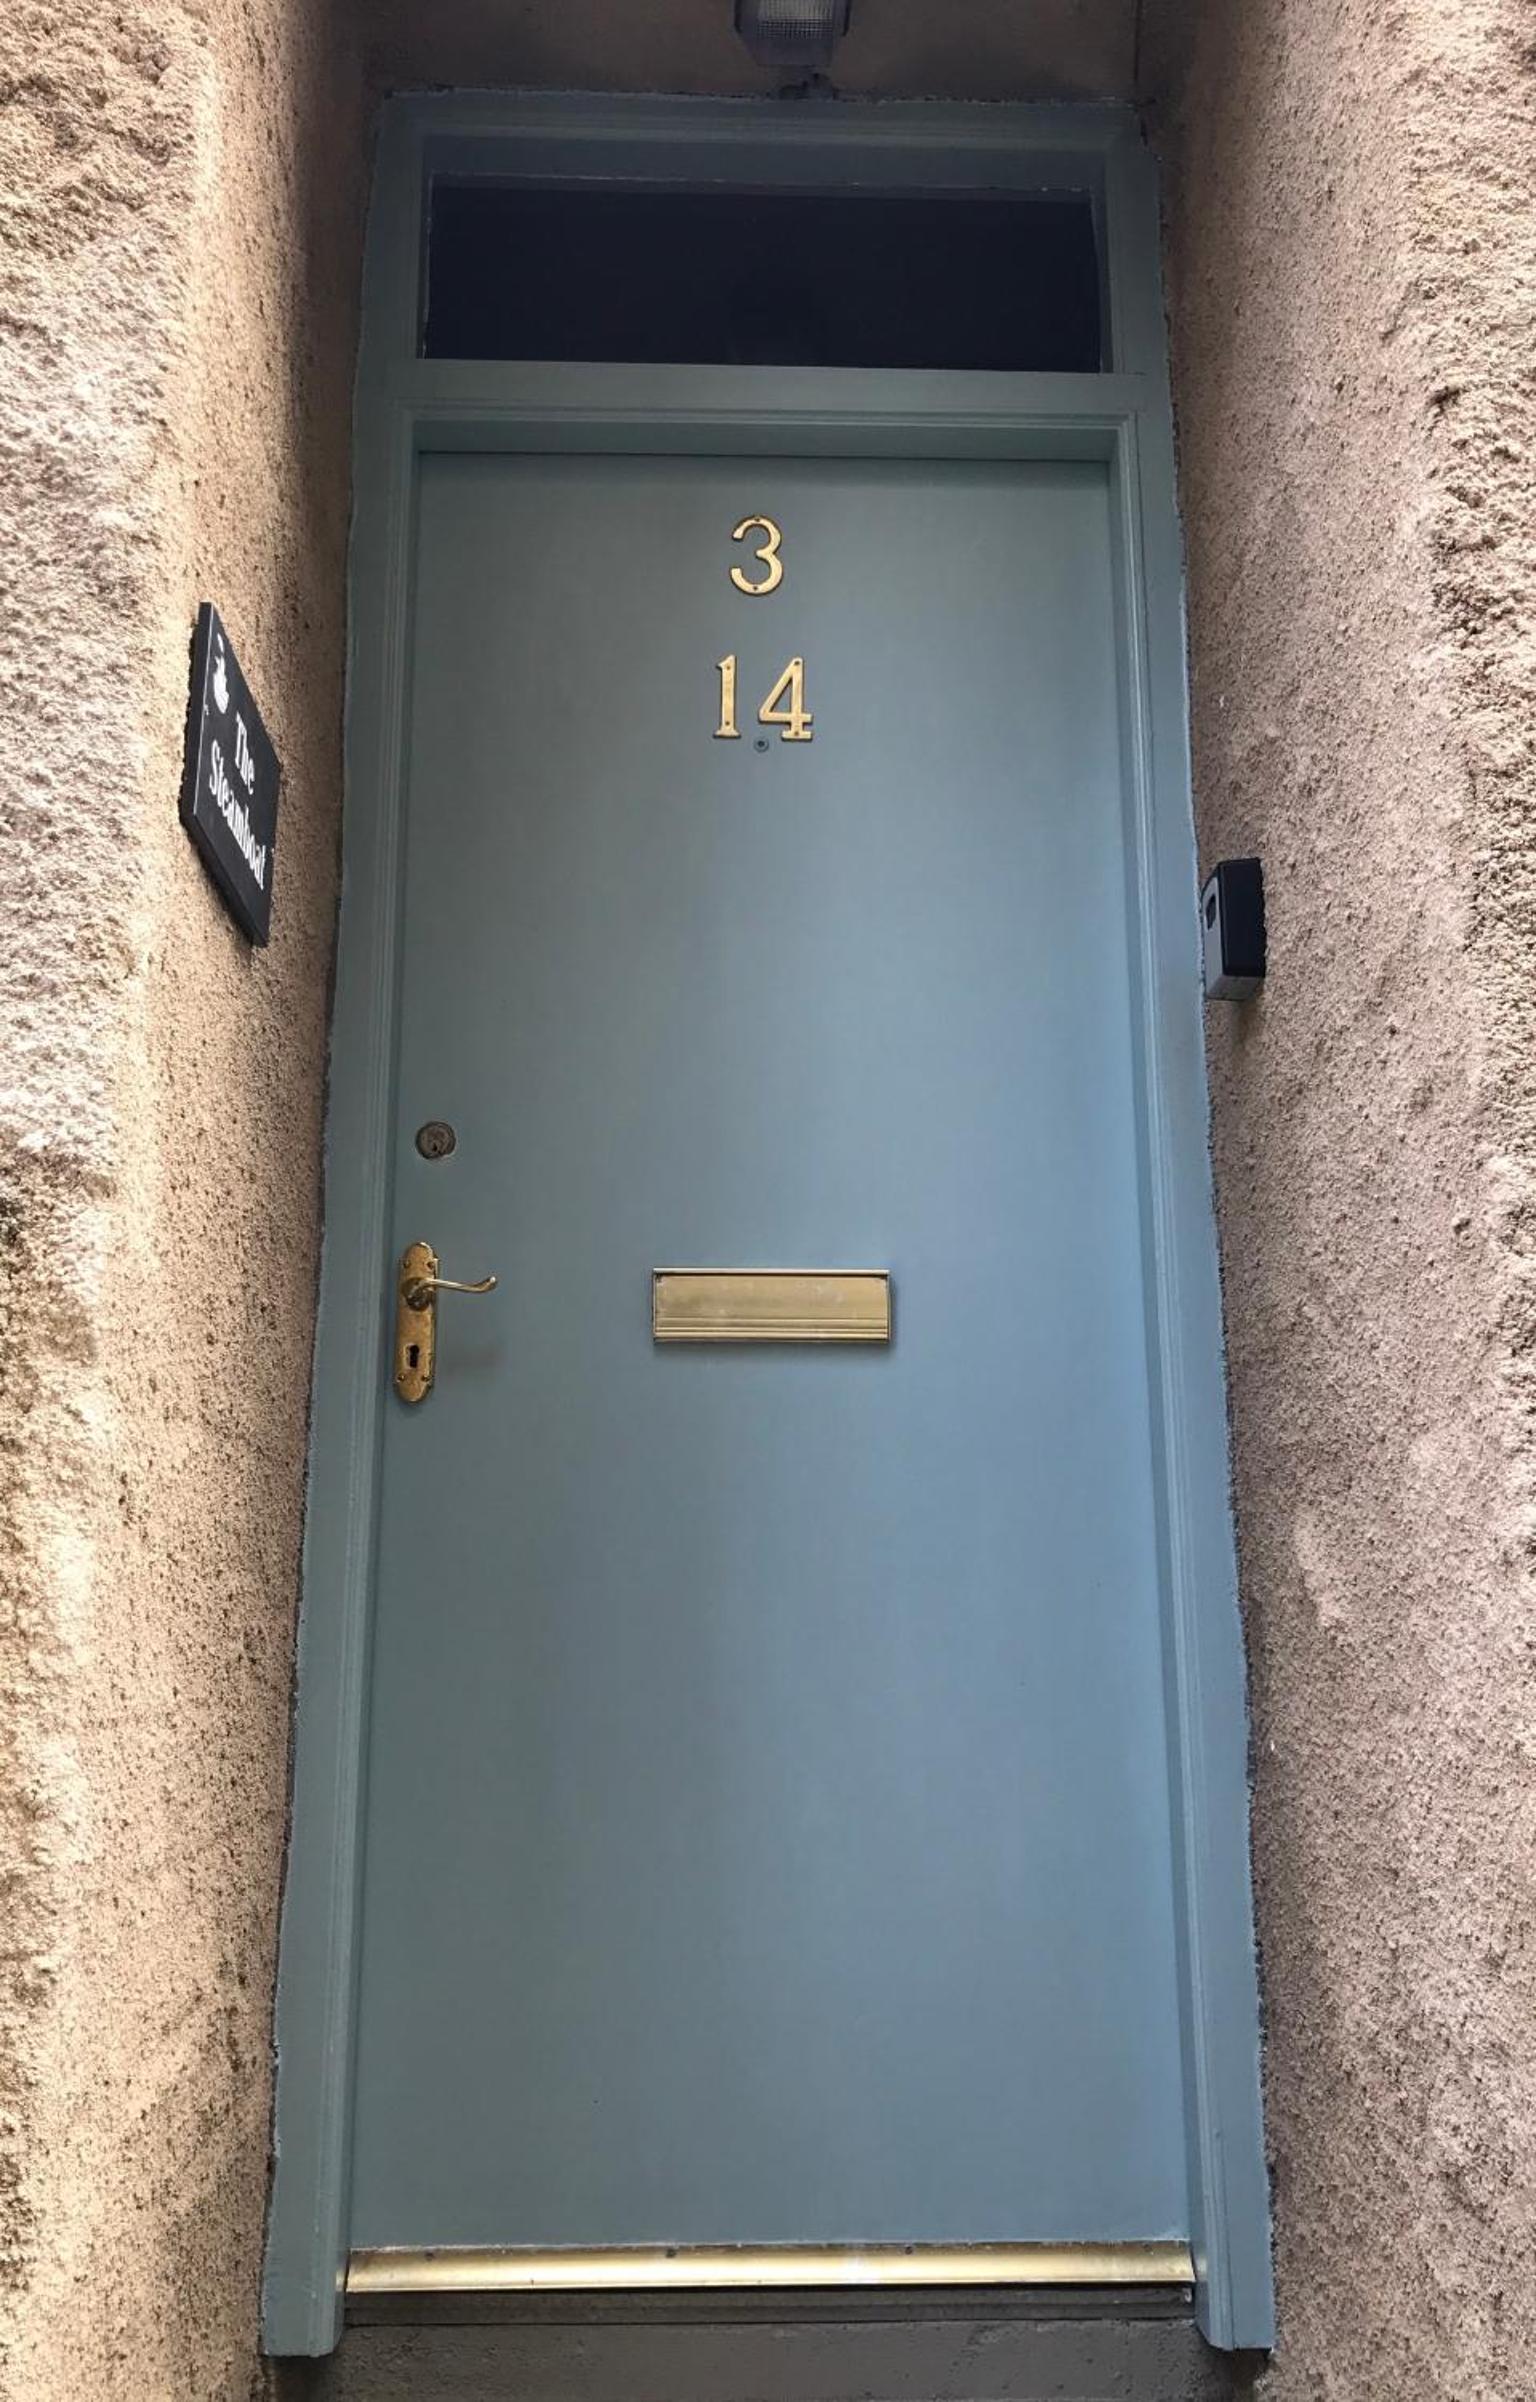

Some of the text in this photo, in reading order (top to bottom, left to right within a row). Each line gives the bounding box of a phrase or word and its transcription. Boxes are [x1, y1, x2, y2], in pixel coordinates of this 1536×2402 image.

[730, 515, 783, 595] 3
[713, 654, 813, 741] 14
[235, 711, 255, 795] The
[209, 739, 266, 890] Steamboat
